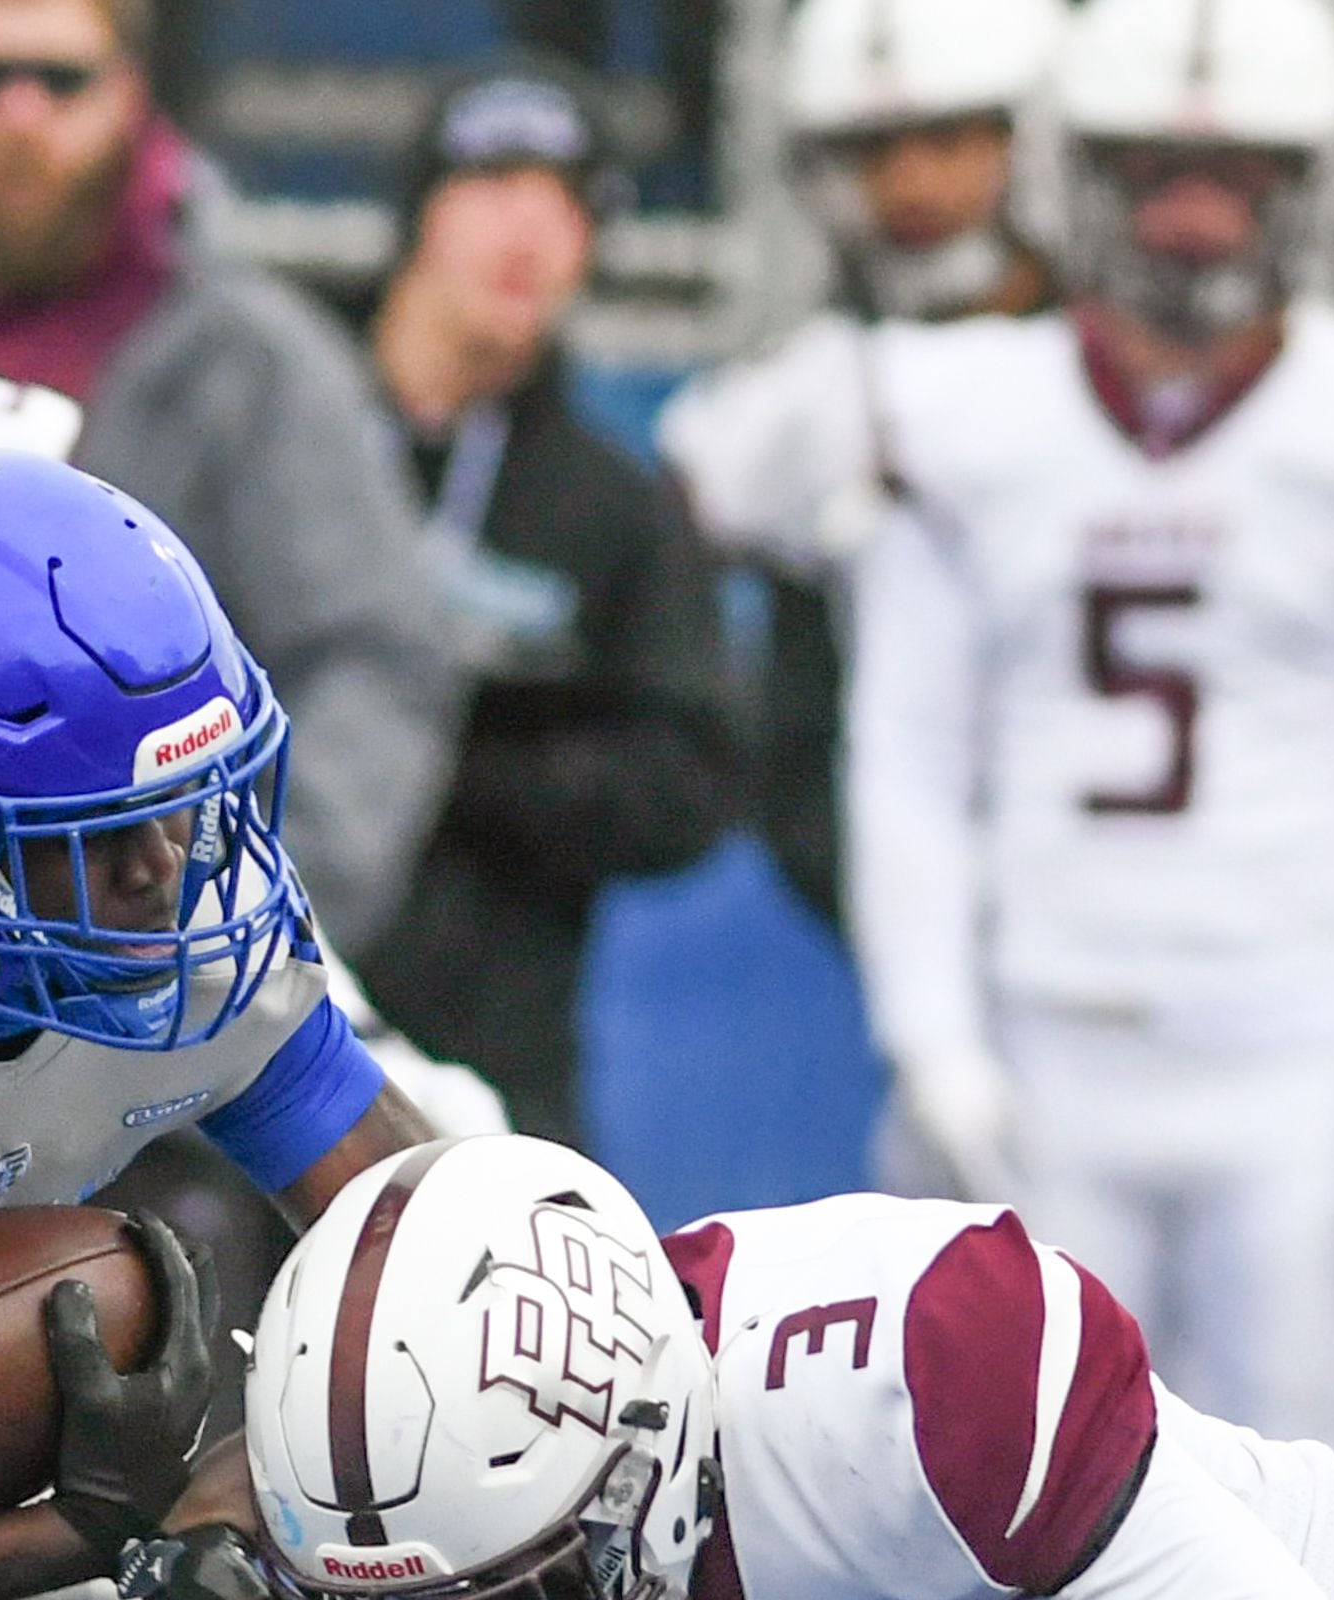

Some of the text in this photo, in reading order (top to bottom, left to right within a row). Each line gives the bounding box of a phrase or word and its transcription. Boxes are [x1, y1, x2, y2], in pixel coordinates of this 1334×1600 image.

[155, 709, 232, 766] Riddell
[1081, 583, 1201, 816] 5
[764, 1295, 878, 1391] 3
[322, 1555, 425, 1579] Riddell
